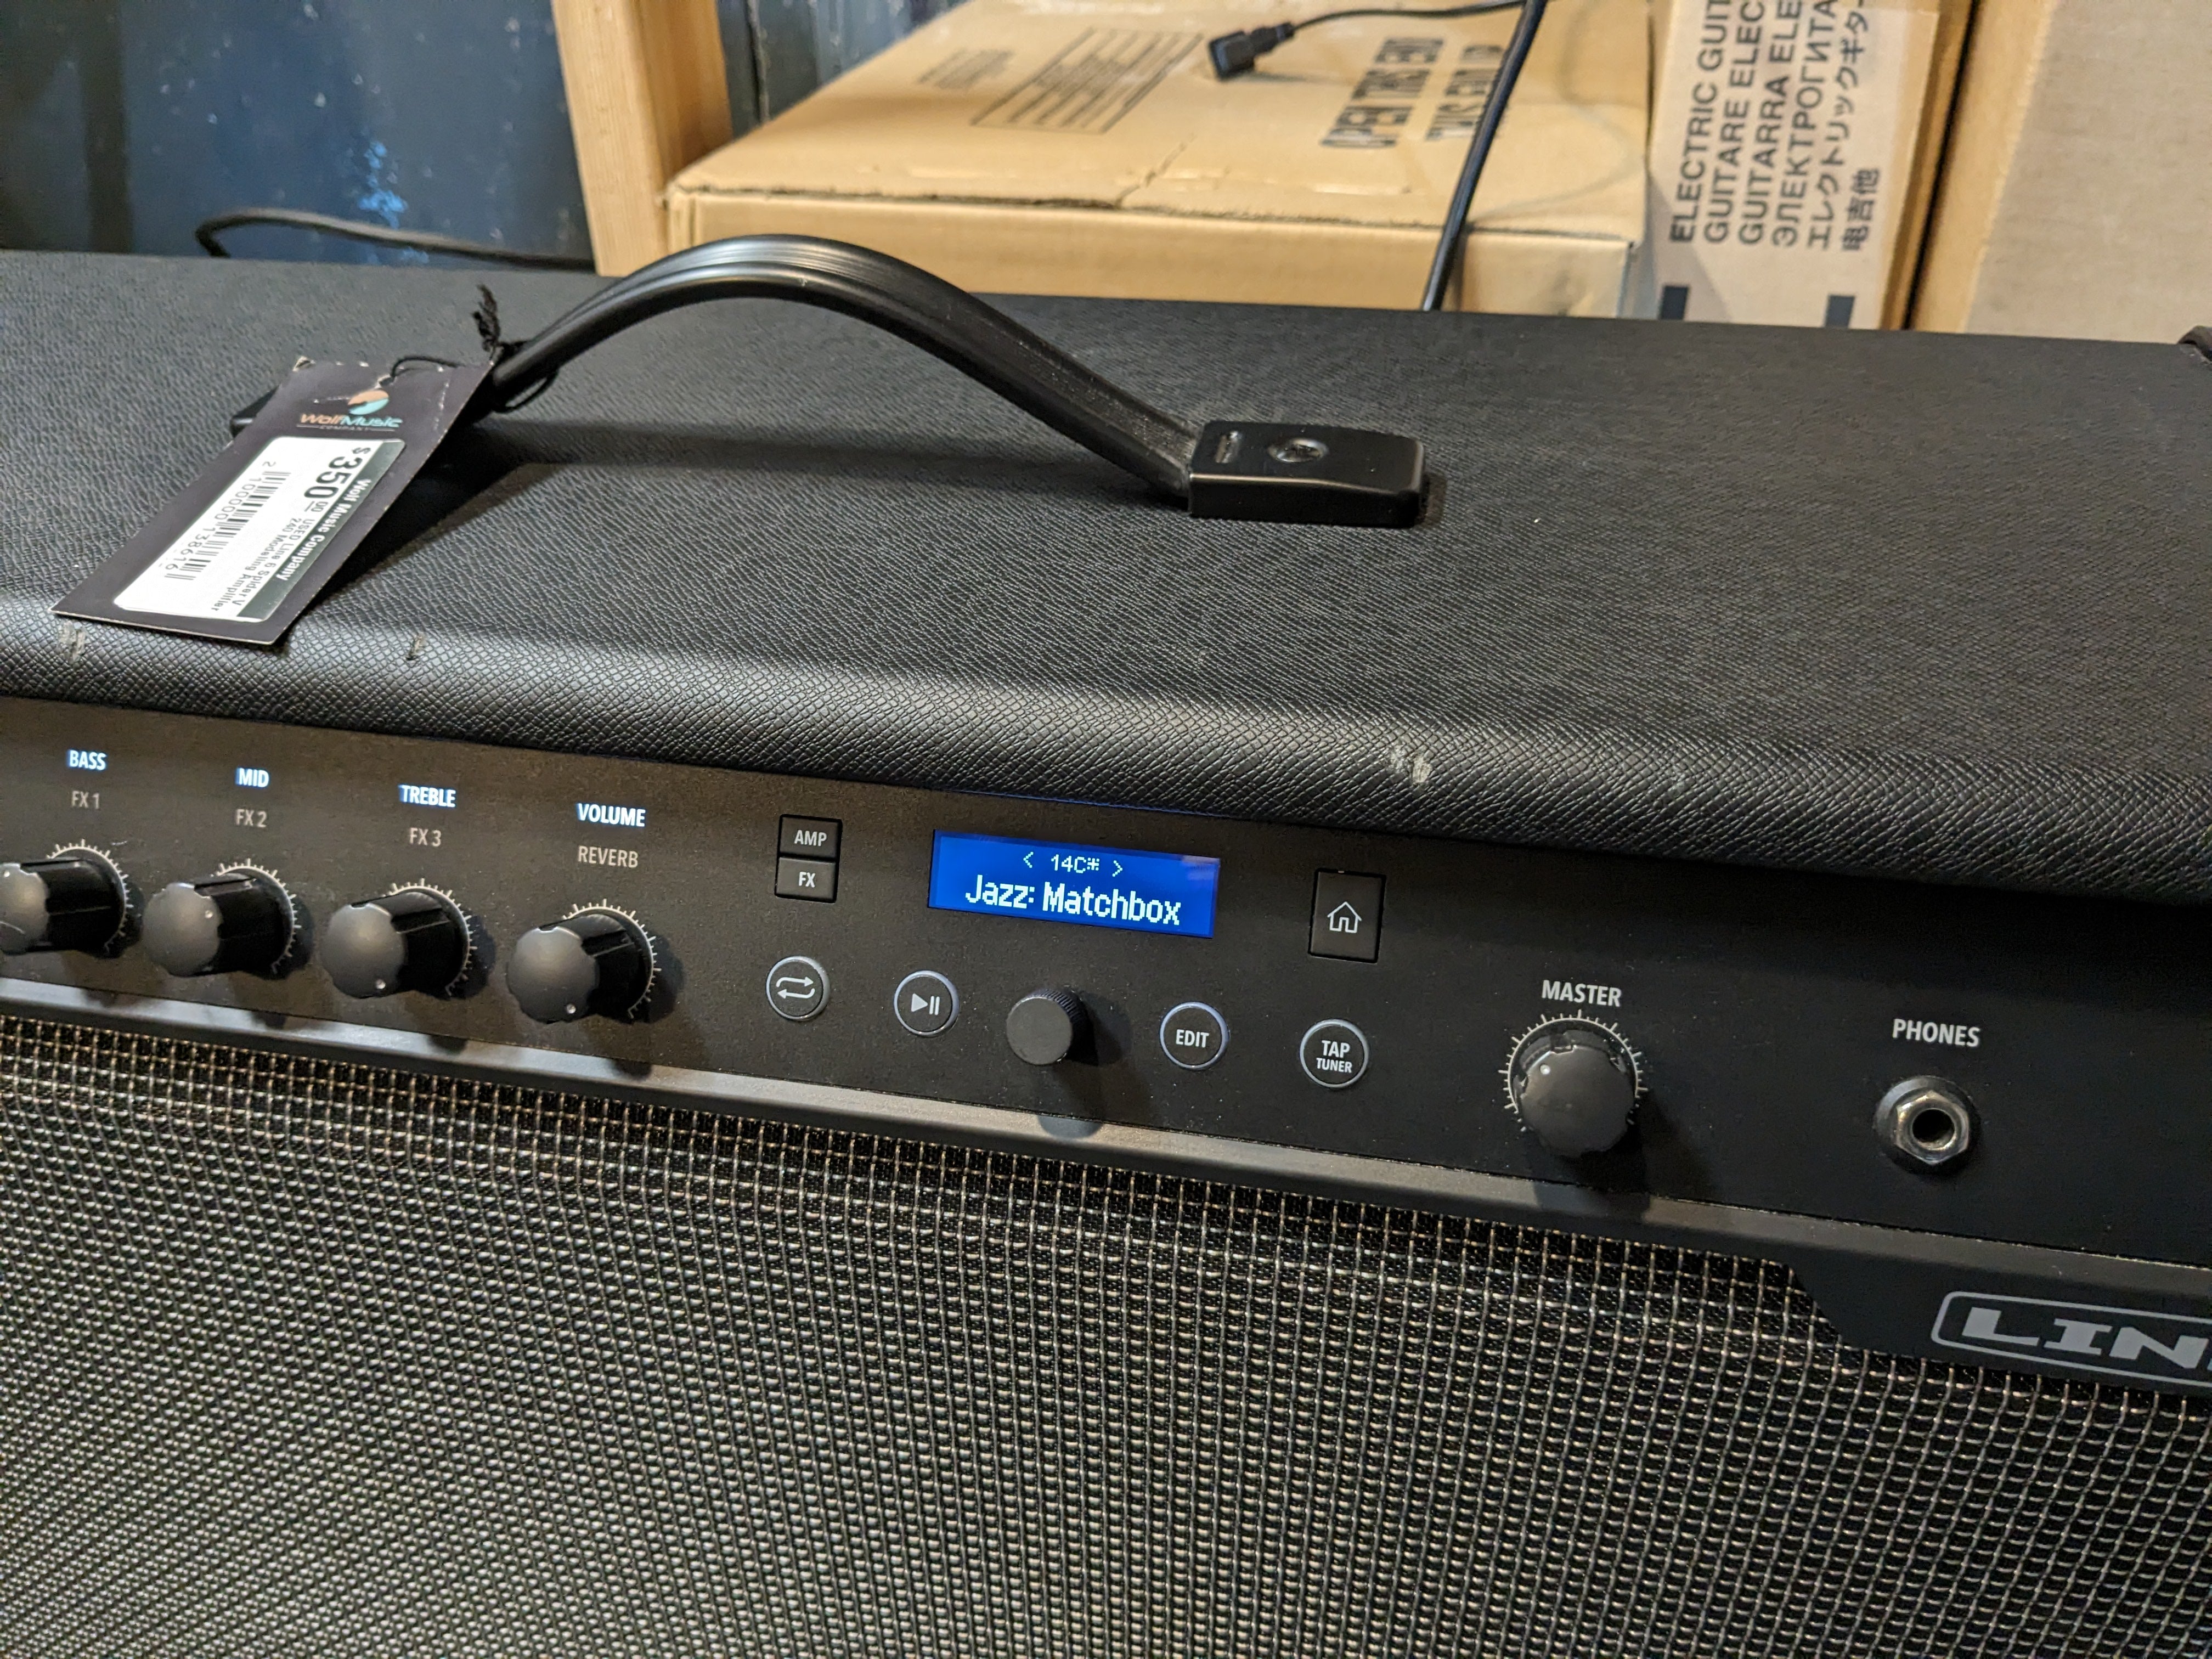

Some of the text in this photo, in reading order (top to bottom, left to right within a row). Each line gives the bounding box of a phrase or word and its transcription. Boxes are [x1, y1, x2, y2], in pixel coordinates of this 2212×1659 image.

[1703, 1, 1765, 243] GUITARE ELEC
[1771, 0, 1839, 247] ЭЛЕКТРОГИТА
[1669, 82, 1718, 243] ELECTRIC
[1738, 75, 1790, 245] GUITARRA
[276, 478, 372, 581] Wolf Music Company
[289, 518, 315, 540] USED
[271, 543, 294, 560] Line
[211, 517, 302, 611] 240 Modeling Amplifier
[239, 570, 270, 596] Spider
[68, 749, 107, 770] BASS
[236, 768, 269, 788] MID
[71, 791, 89, 808] FX
[399, 785, 456, 808] TREBLE
[236, 809, 254, 826] FX
[577, 803, 646, 827] VOLUME
[410, 827, 428, 845] FX
[794, 830, 827, 847] AMP
[577, 845, 639, 868] REVERB
[799, 872, 816, 888] FX
[965, 874, 1181, 926] Jazz: Matchbox
[1541, 979, 1622, 1007] MASTER
[1176, 1029, 1209, 1048] EDIT
[1892, 1018, 1980, 1047] PHONES
[1321, 1040, 1351, 1058] TAP
[1316, 1057, 1352, 1074] TUNER
[1961, 1306, 2212, 1370] LIN
